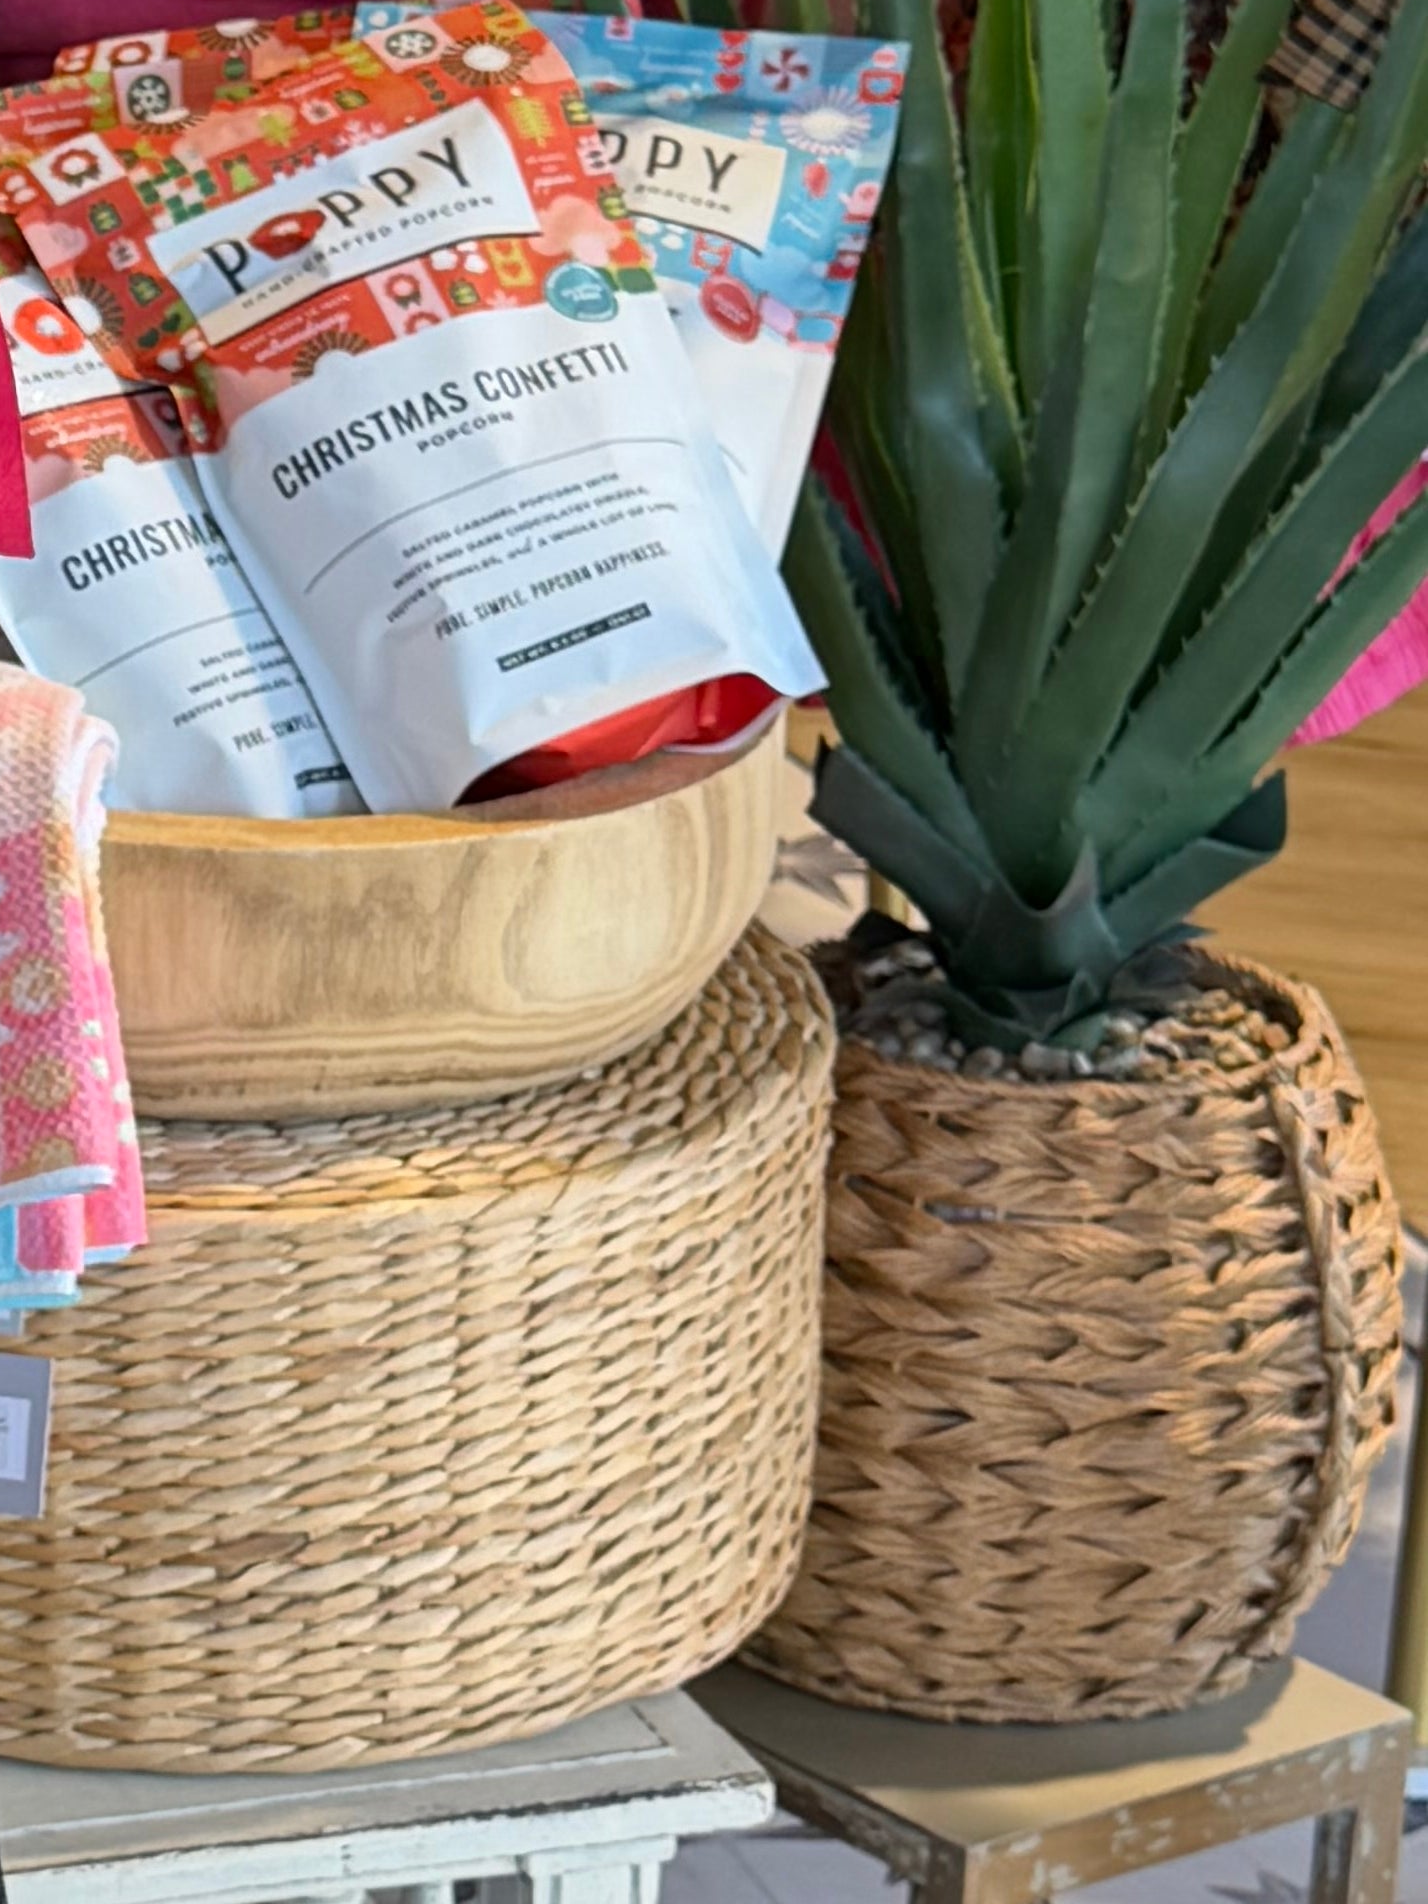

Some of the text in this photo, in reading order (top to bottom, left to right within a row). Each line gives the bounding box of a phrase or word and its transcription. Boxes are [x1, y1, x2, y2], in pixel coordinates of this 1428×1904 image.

[399, 195, 495, 231] POPCORN
[271, 341, 630, 501] CHRISTMAS CONFETTI
[416, 410, 515, 455] POPCORN
[60, 510, 226, 592] CHRISTMA
